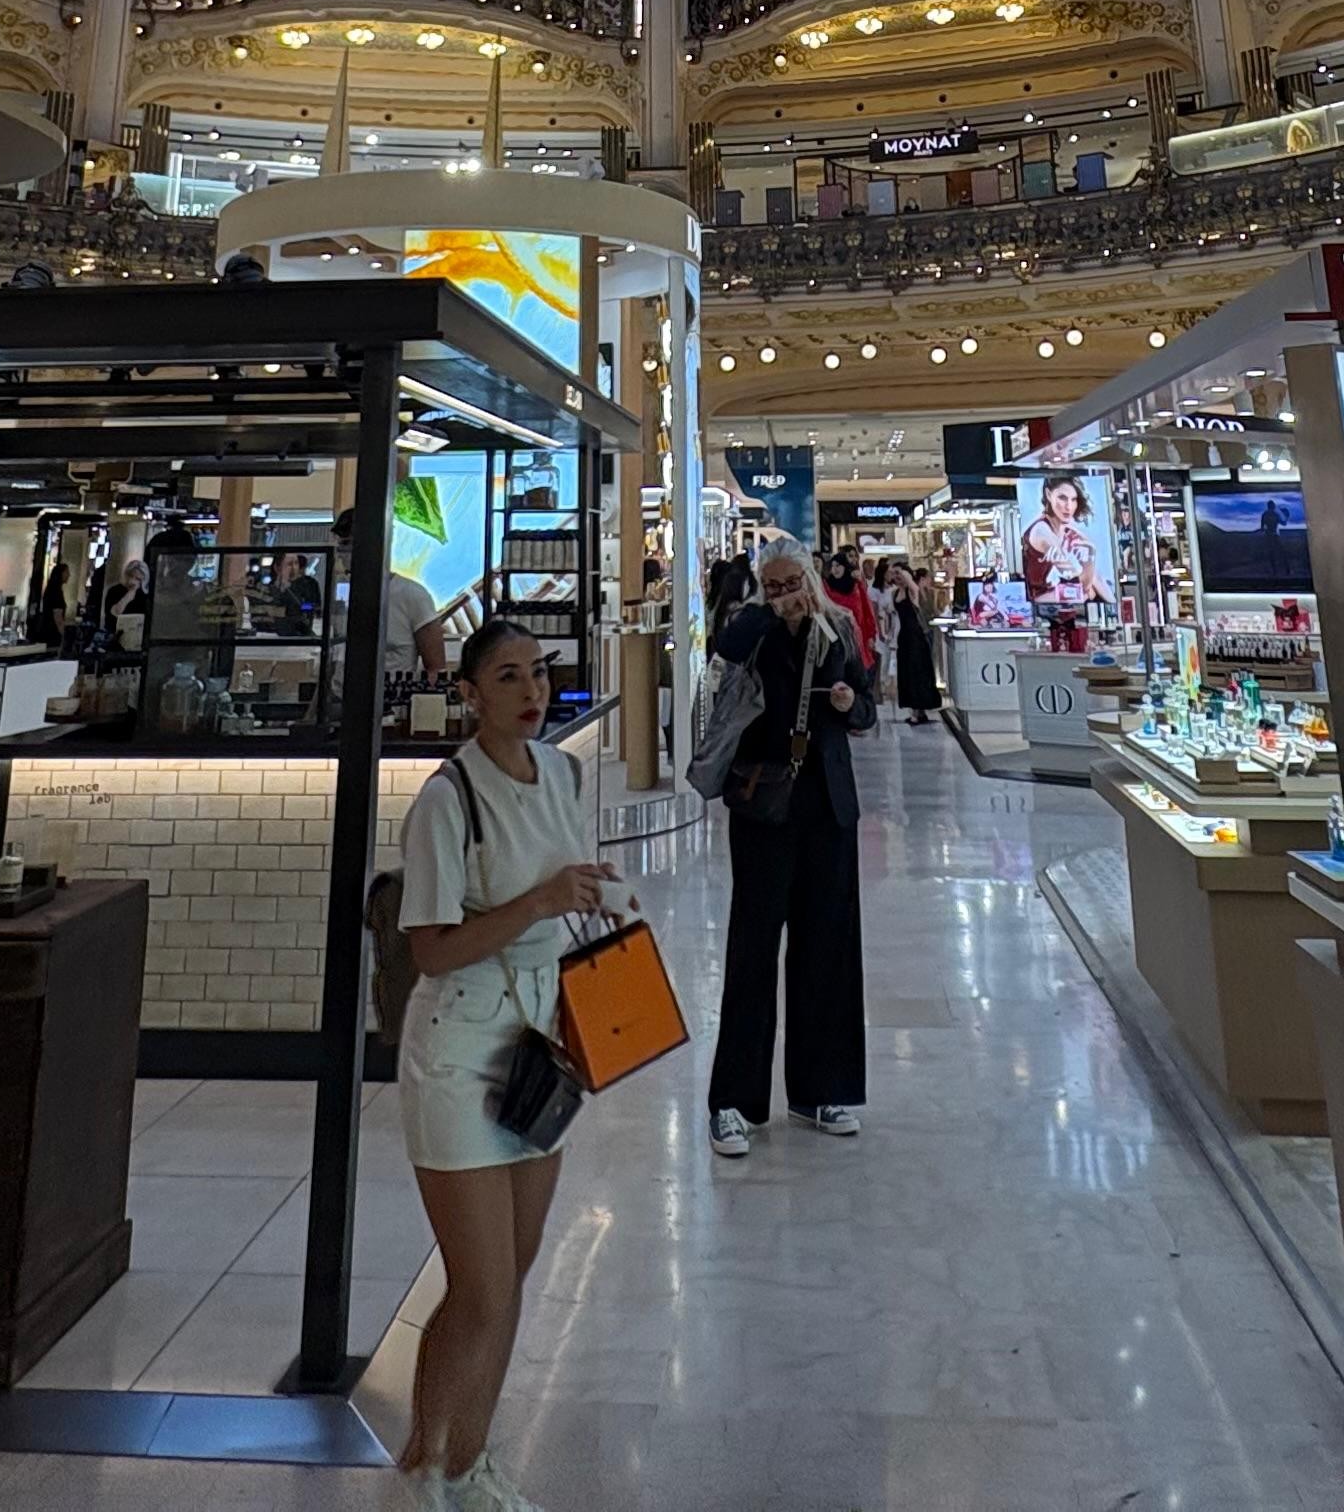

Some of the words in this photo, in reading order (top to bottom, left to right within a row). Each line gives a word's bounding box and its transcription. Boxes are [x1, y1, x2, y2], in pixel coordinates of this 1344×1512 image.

[883, 133, 962, 155] MOYNAT
[751, 474, 787, 489] FRED
[856, 506, 901, 517] MESSIKA
[34, 783, 100, 796] fragrance
